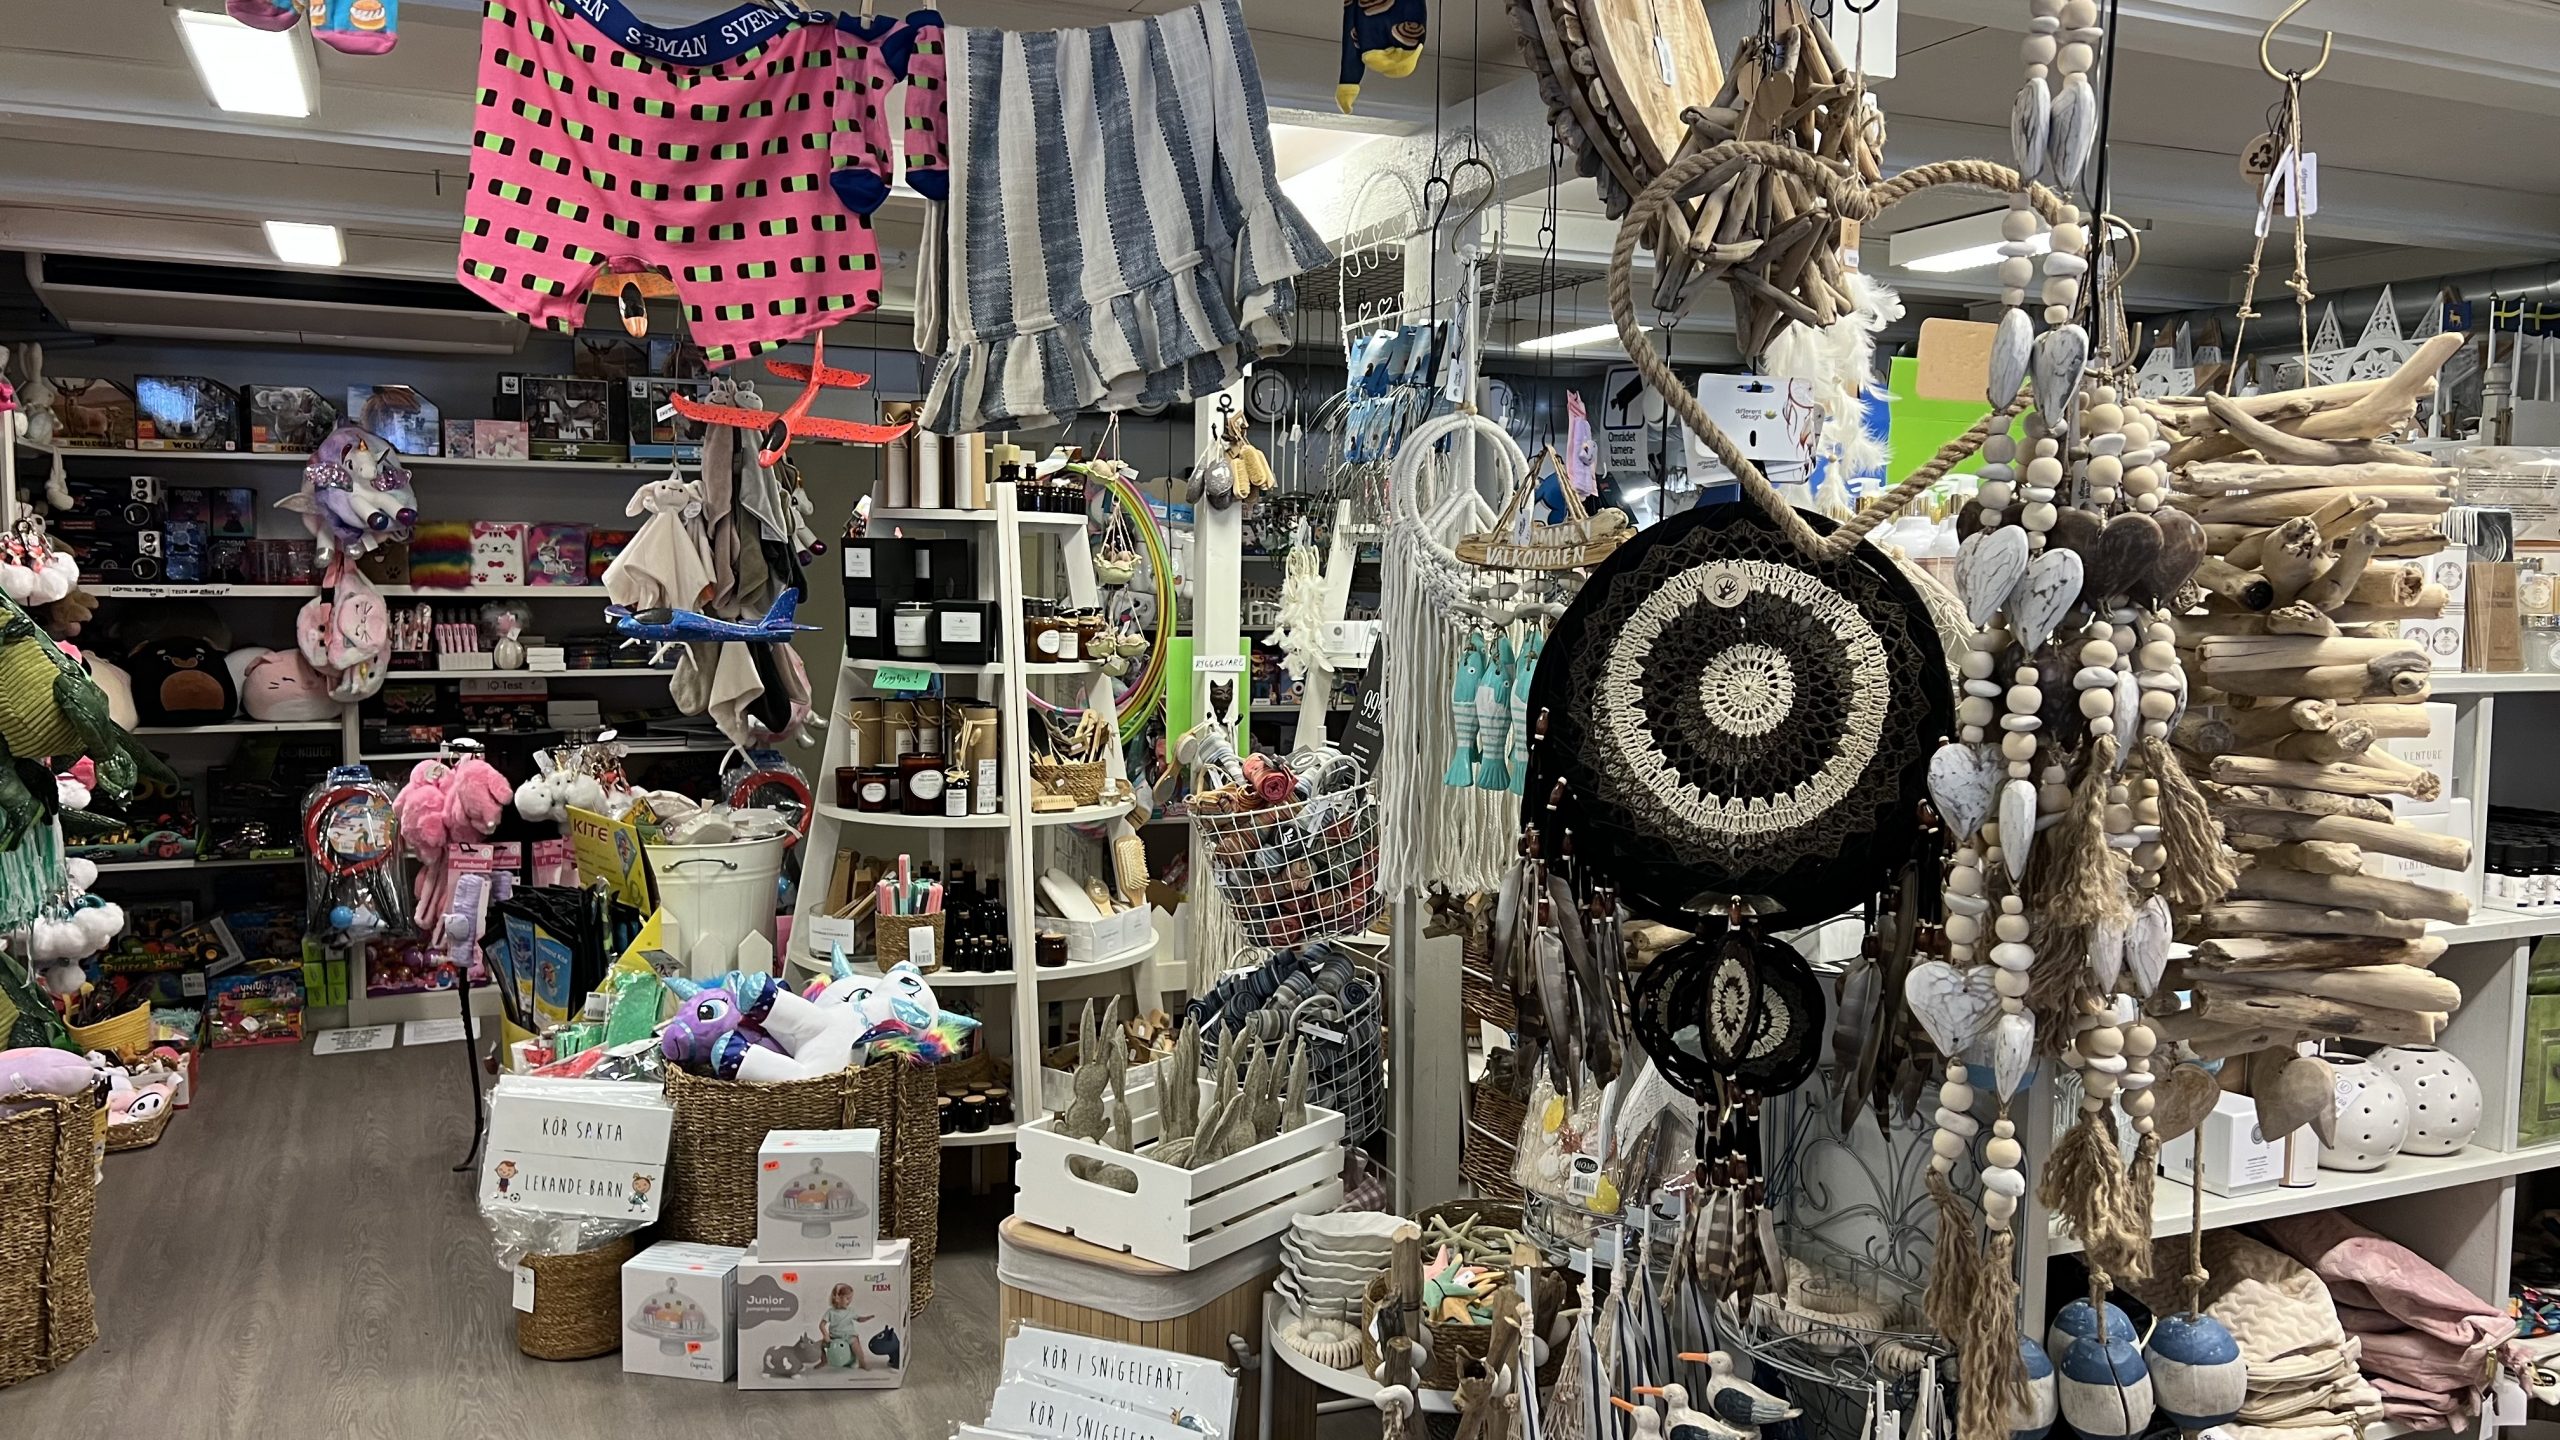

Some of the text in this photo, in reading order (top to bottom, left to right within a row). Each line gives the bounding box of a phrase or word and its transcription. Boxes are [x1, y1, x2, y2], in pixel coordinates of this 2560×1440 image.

[1735, 407, 1762, 415] different
[1740, 413, 1762, 421] design
[1486, 545, 1586, 569] VÄLKOMMEN
[1241, 579, 1283, 600] Prinse
[1250, 603, 1278, 626] Prin
[2403, 750, 2443, 761] VENTURE
[573, 818, 609, 842] KITE
[542, 1115, 623, 1142] KÖR SAKTA
[1575, 1160, 1597, 1172] HOME
[525, 1174, 623, 1199] LEKANDE BARN
[746, 1295, 785, 1305] Junior
[1042, 1344, 1068, 1371] KÖR
[1077, 1353, 1082, 1374] I
[1029, 1400, 1055, 1428] KÖR
[1062, 1411, 1068, 1432] I
